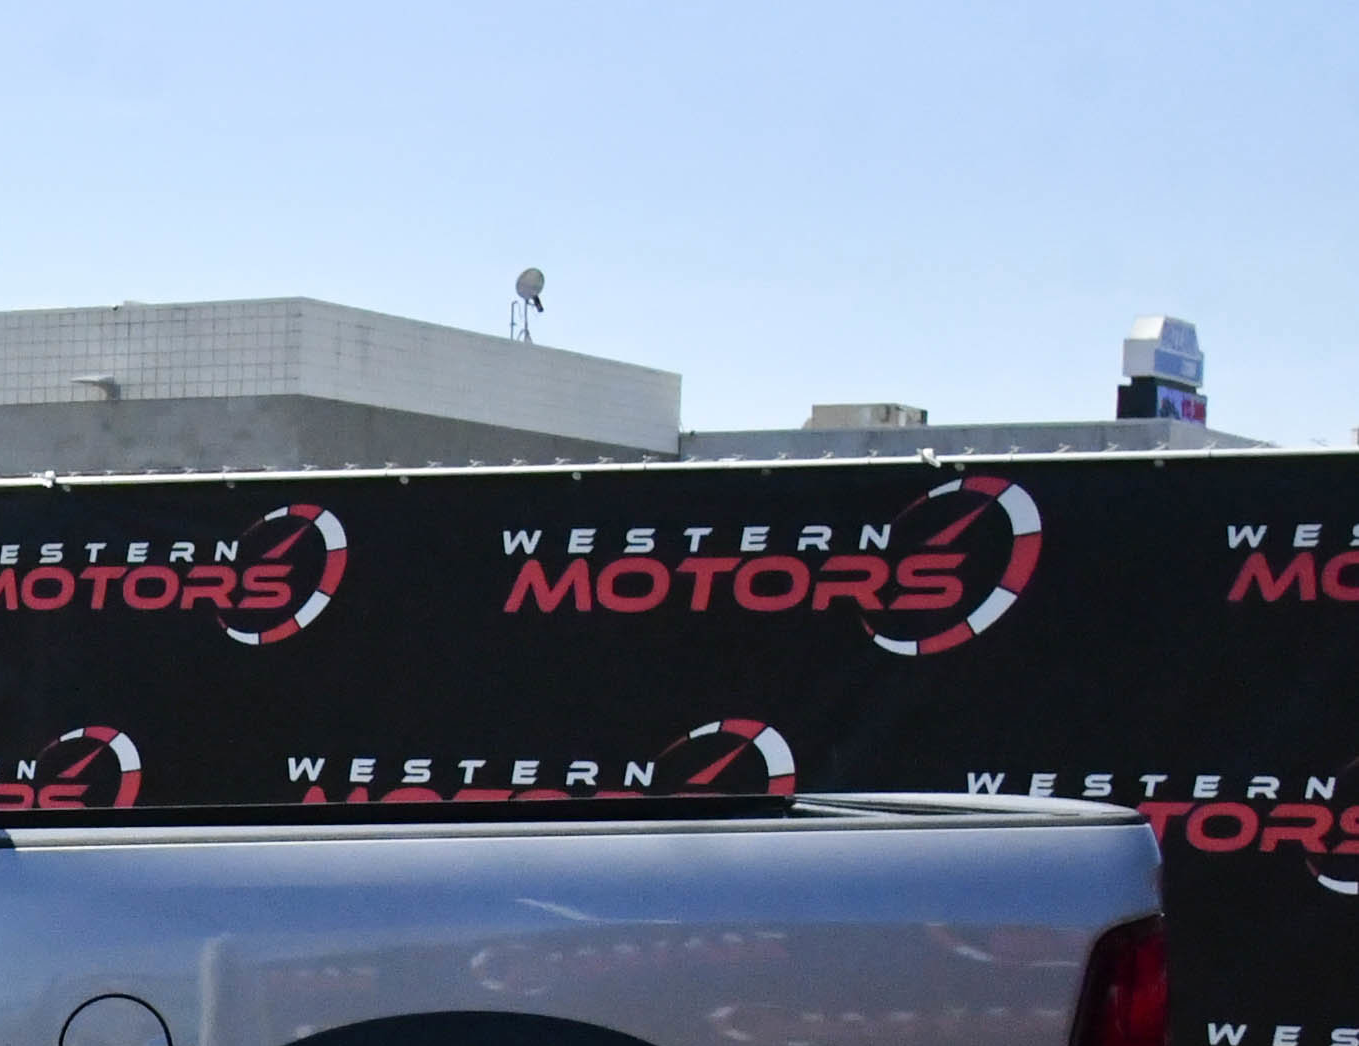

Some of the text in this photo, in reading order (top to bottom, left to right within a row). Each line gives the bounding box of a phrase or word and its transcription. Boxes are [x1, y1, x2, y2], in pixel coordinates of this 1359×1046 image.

[503, 525, 891, 554] WESTERN
[504, 553, 967, 613] MOTORS
[287, 757, 654, 786] WESTERN
[967, 772, 1336, 799] WESTERN
